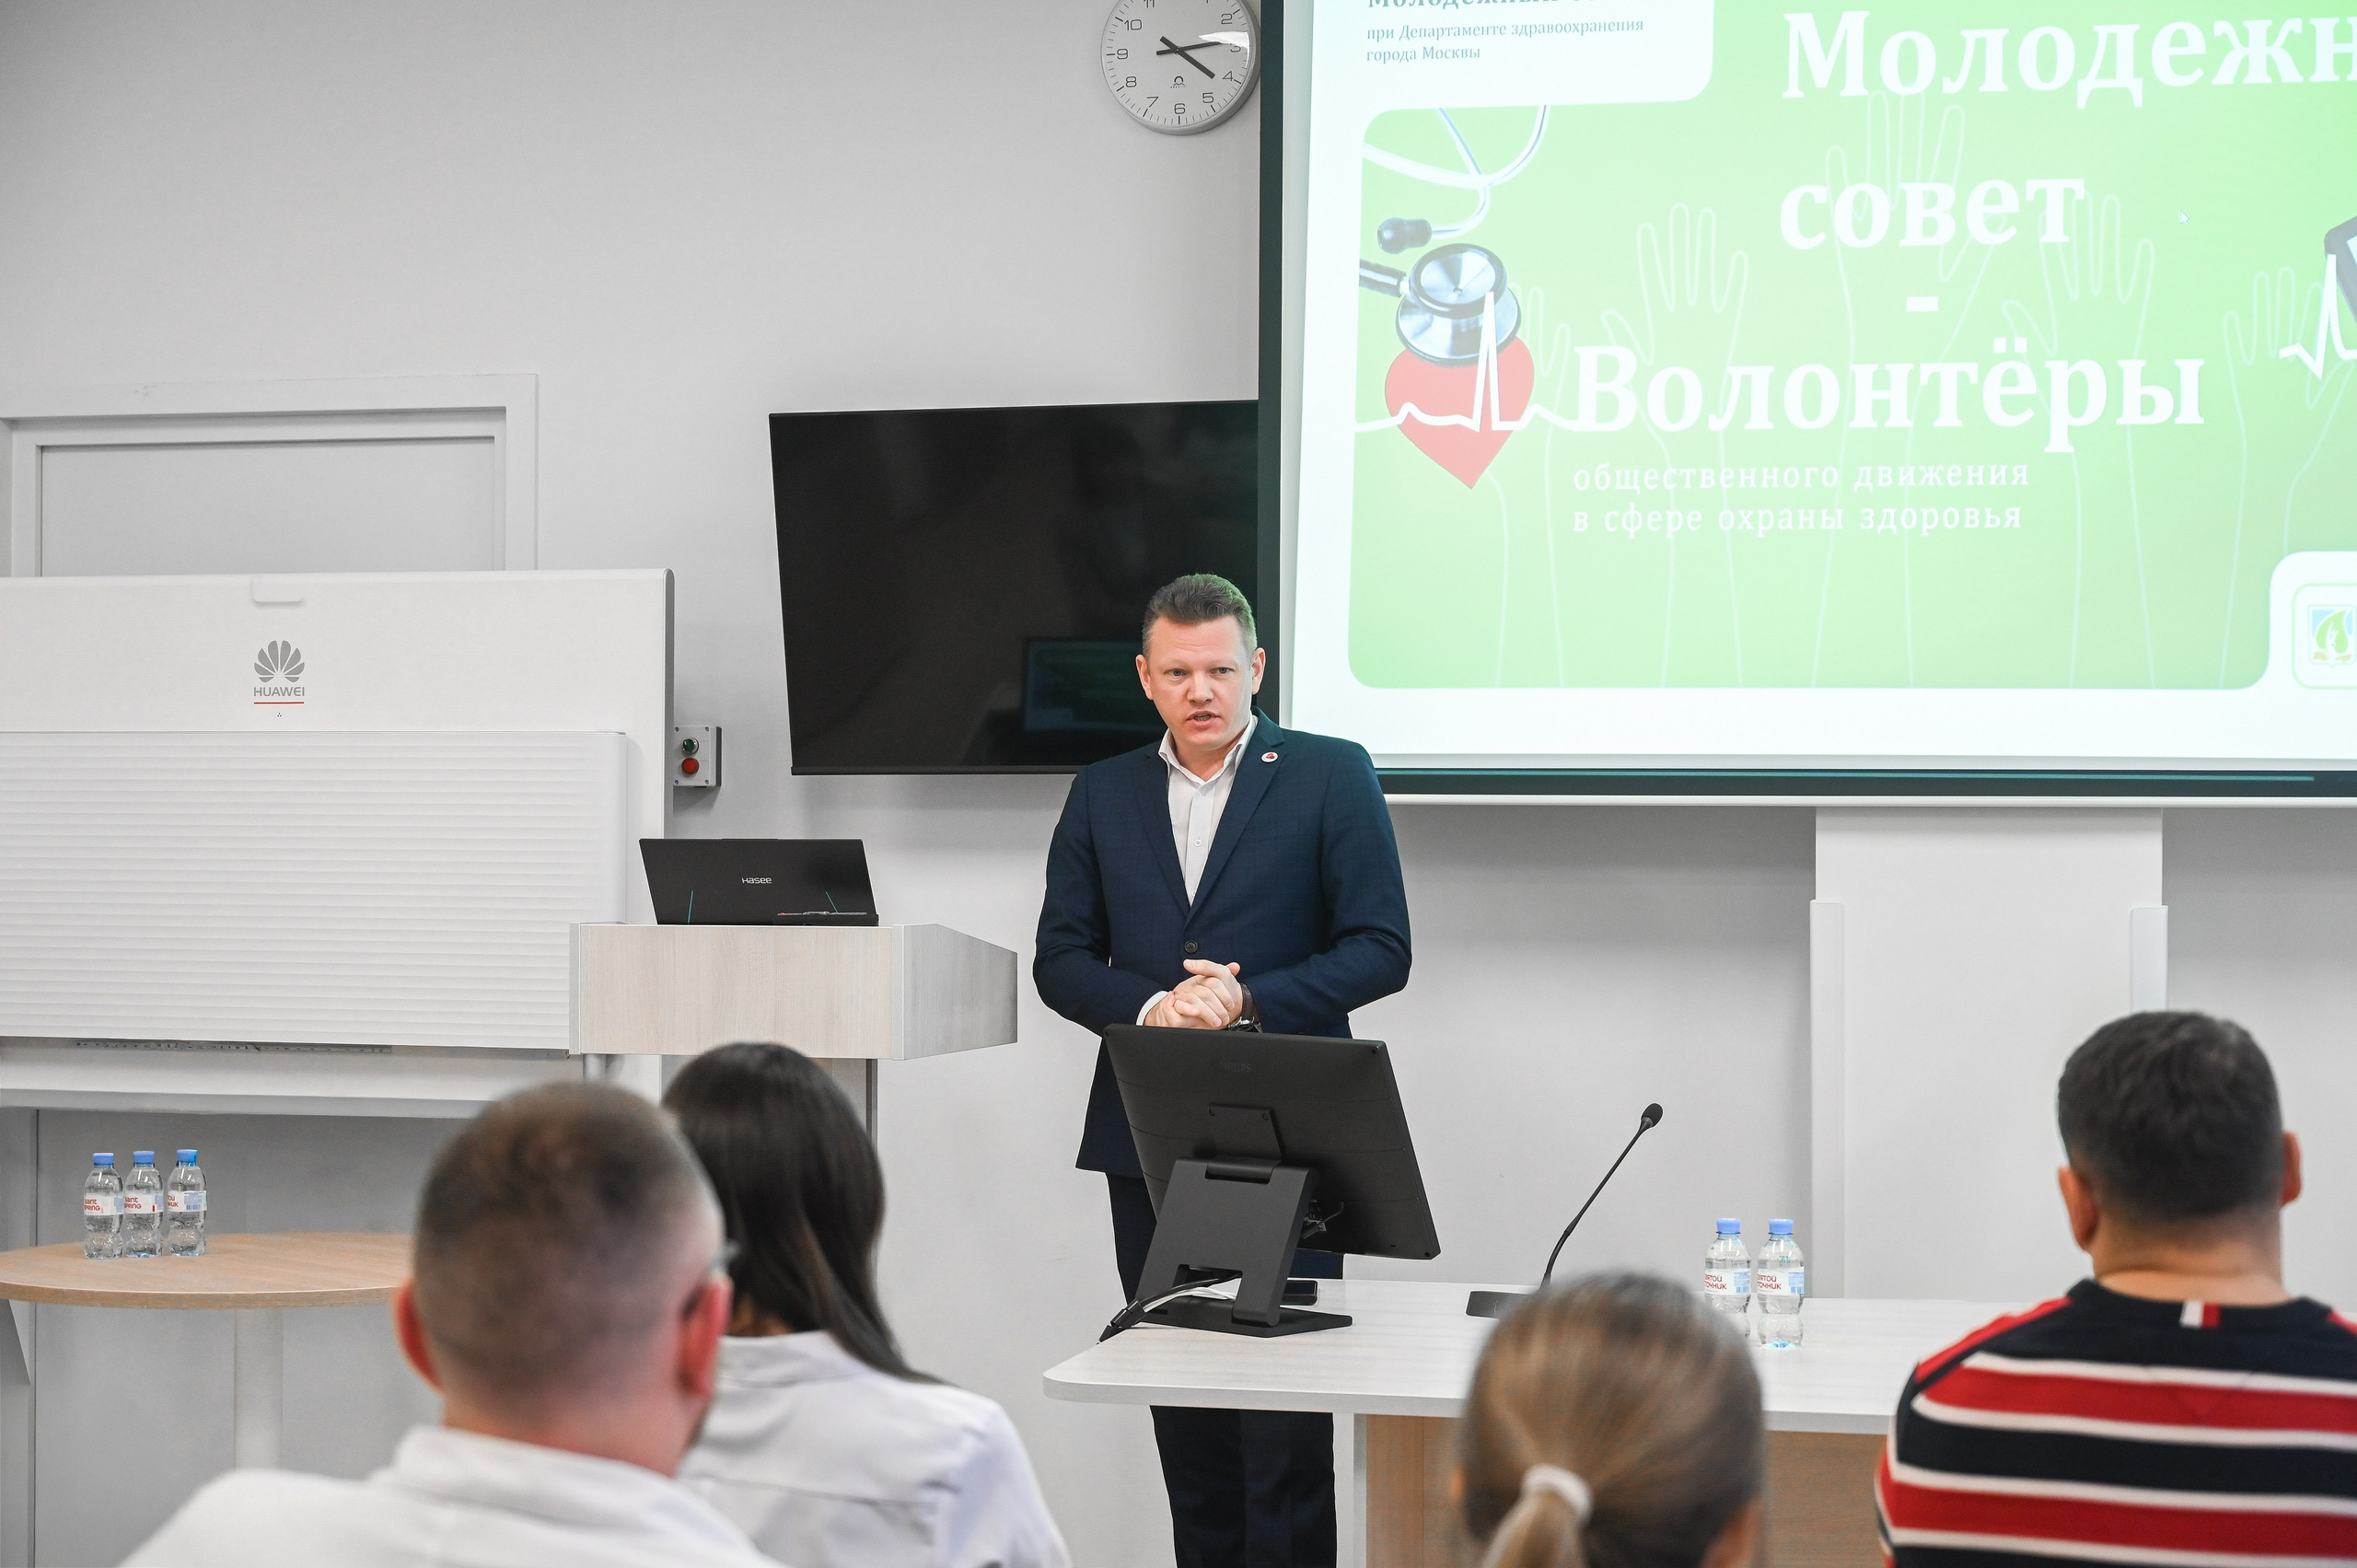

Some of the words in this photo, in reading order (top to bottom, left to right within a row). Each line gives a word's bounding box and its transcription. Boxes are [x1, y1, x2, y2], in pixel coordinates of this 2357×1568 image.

[1124, 19, 1143, 31] 10
[1221, 13, 1233, 25] 2
[1367, 27, 1395, 42] при
[1399, 23, 1507, 41] Департаменте
[1511, 19, 1644, 38] здравоохранения
[1117, 48, 1129, 60] 9
[1366, 51, 1417, 64] города
[1422, 46, 1481, 60] Москвы
[1125, 75, 1137, 87] 8
[1223, 70, 1234, 82] 4
[1147, 96, 1159, 108] 7
[1202, 92, 1214, 104] 5
[1174, 103, 1186, 115] 6
[1780, 179, 2084, 250] совет
[1573, 337, 2206, 452] Волонтёры
[1573, 461, 1840, 495] общественного
[1853, 461, 2029, 493] движения
[1573, 506, 1589, 532] в
[1603, 501, 1703, 539] сфере
[1717, 506, 1844, 538] охраны
[1859, 503, 2023, 536] здоровья
[253, 686, 305, 697] HUAWEI
